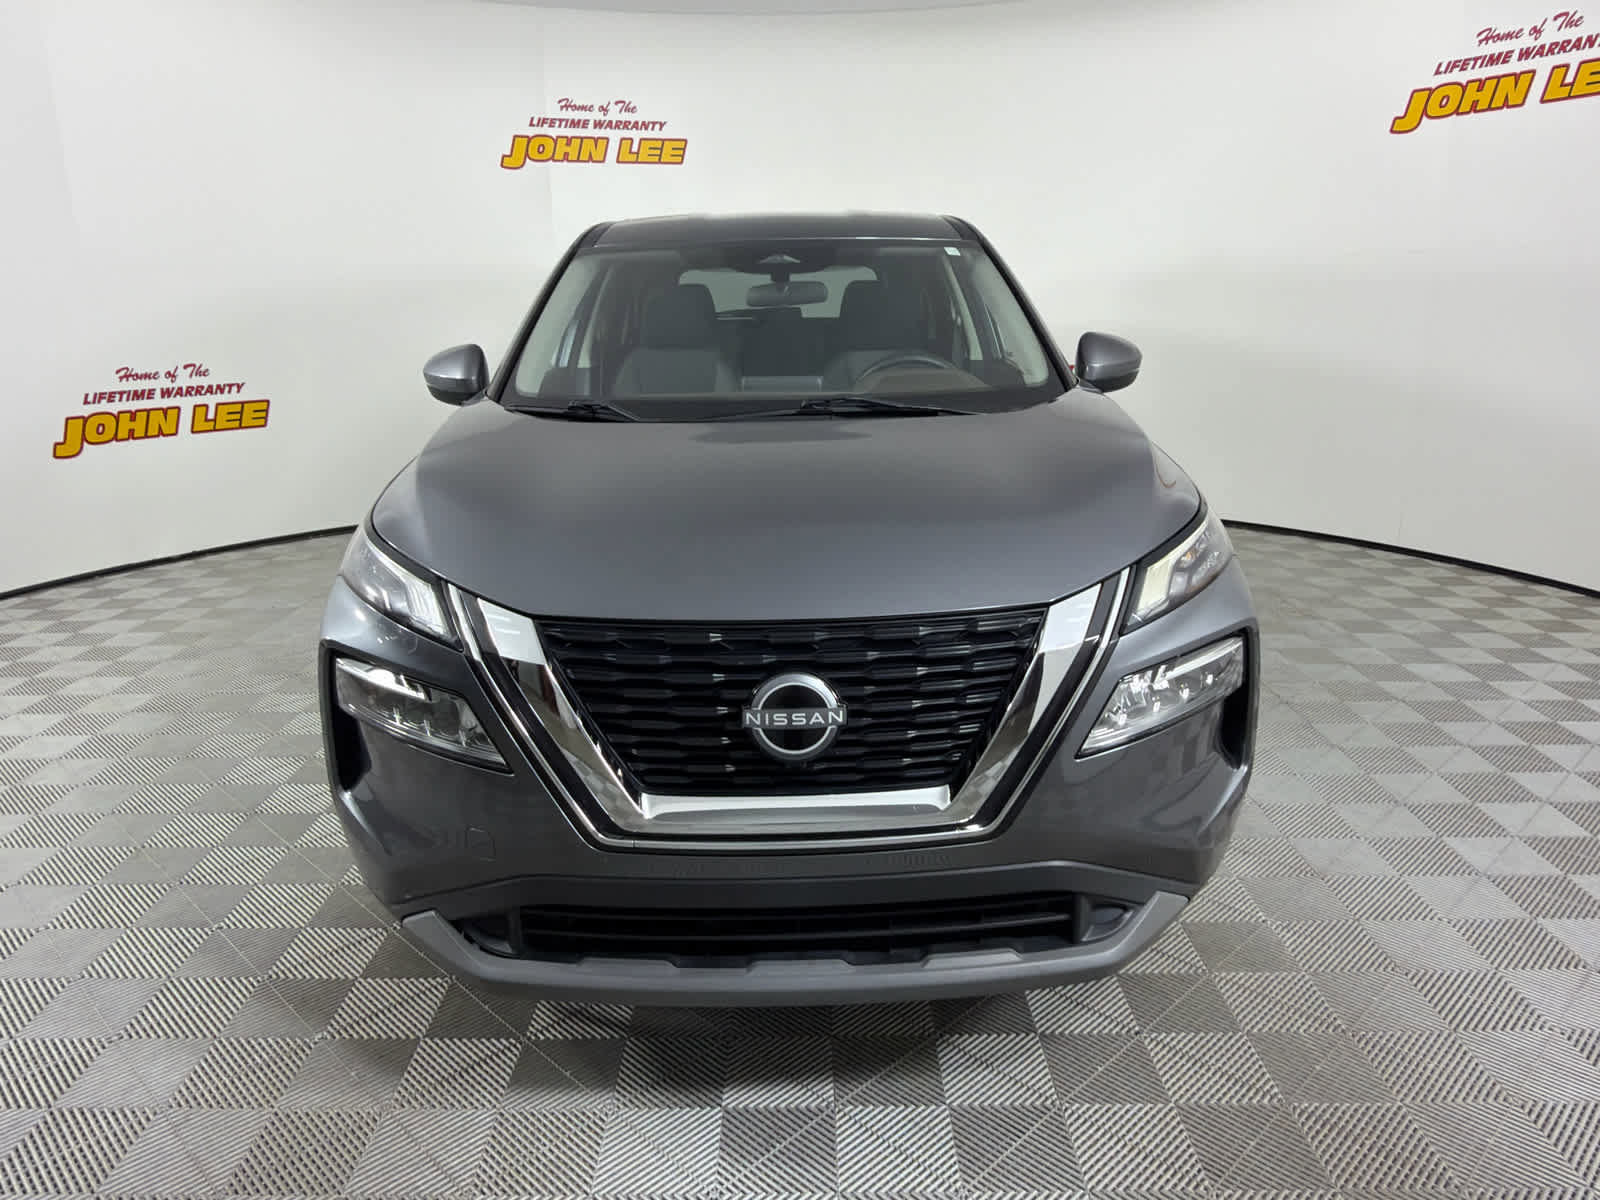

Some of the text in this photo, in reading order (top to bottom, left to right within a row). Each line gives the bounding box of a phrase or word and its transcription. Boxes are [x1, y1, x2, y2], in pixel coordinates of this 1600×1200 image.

[1476, 10, 1585, 47] Home of The
[1433, 33, 1600, 76] LIFETIME WARRAN
[557, 98, 638, 116] Home of The
[1389, 57, 1600, 134] JOHN LE
[528, 116, 667, 132] LIFETIME WARRANTY
[500, 134, 688, 170] JOHN LEE
[115, 363, 210, 383] Home of The
[83, 382, 246, 405] LIFETIME WARRANTY
[53, 399, 270, 459] JOHN LEE
[745, 710, 844, 726] NISSAN
